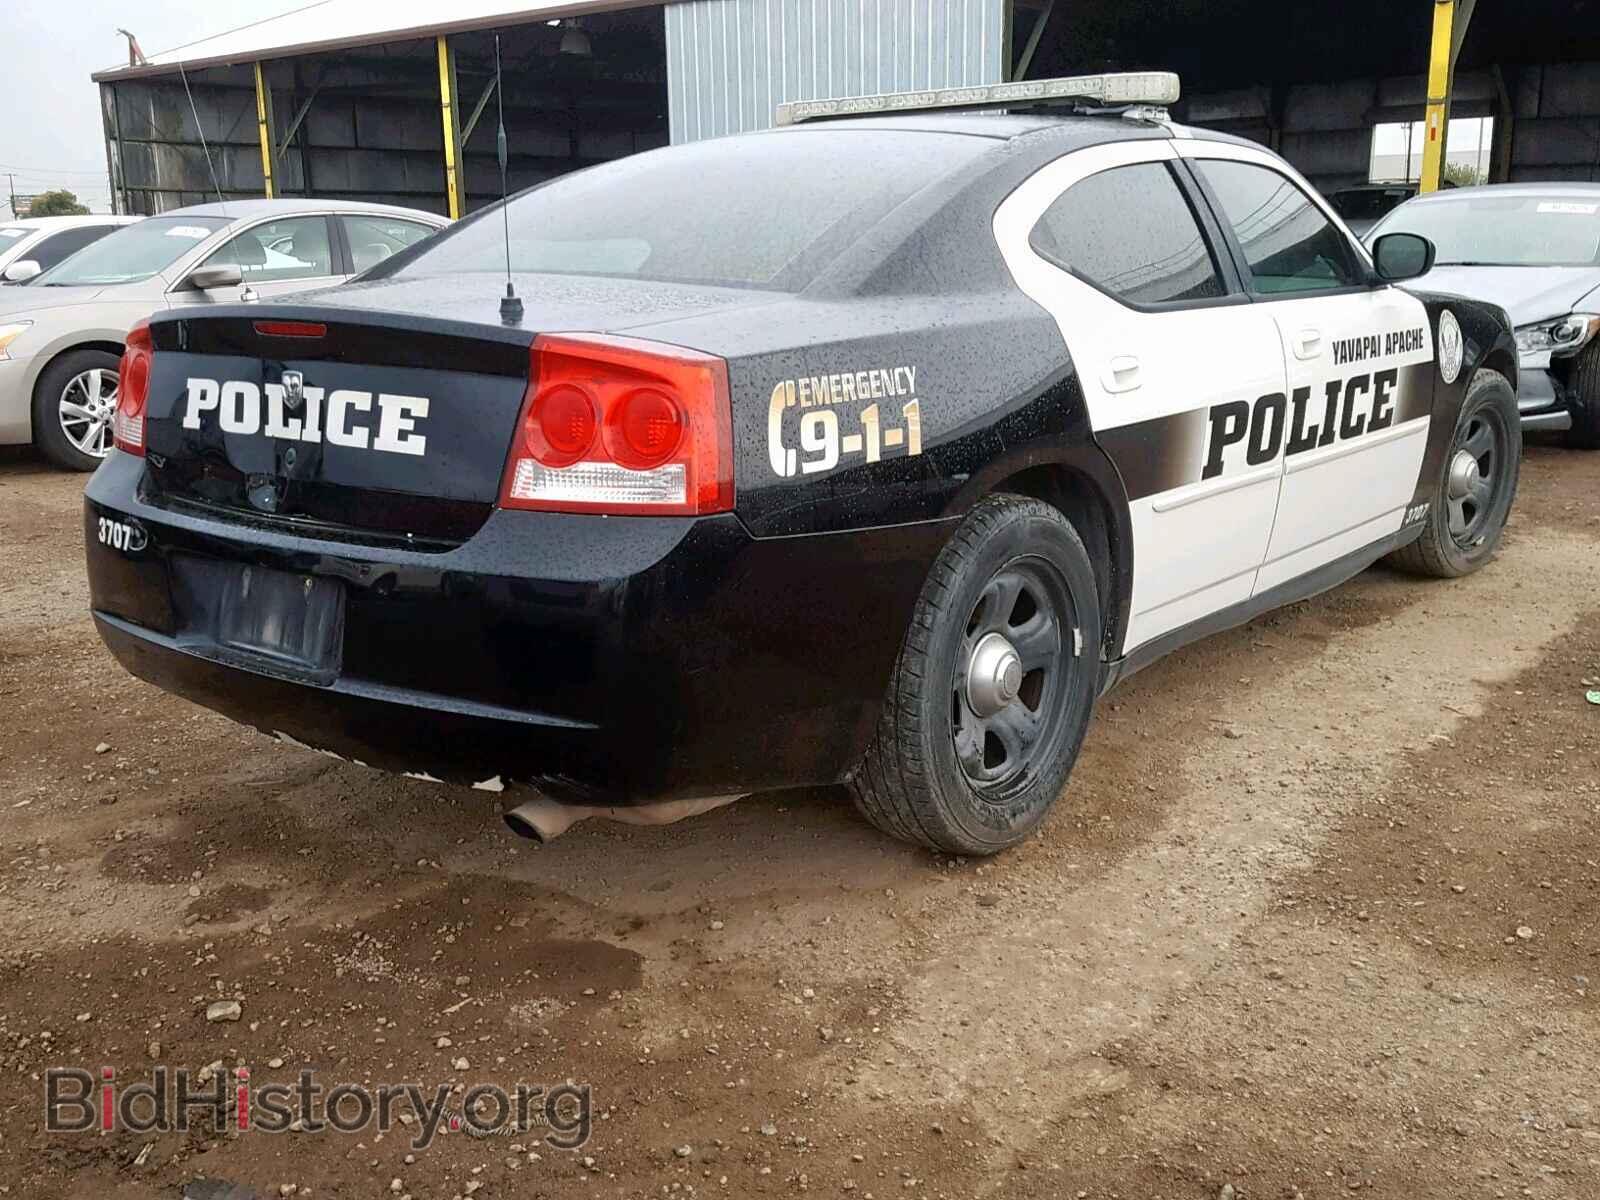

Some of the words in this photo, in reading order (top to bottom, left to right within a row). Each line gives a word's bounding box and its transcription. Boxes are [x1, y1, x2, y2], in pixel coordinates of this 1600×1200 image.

[1332, 335, 1382, 365] YAVAPAI
[1385, 328, 1424, 355] APACHE
[799, 366, 916, 407] EMERGENCY
[182, 378, 430, 456] POLICE
[801, 398, 923, 474] 9-1-1
[1201, 368, 1398, 480] POLICE
[98, 516, 131, 551] 3707
